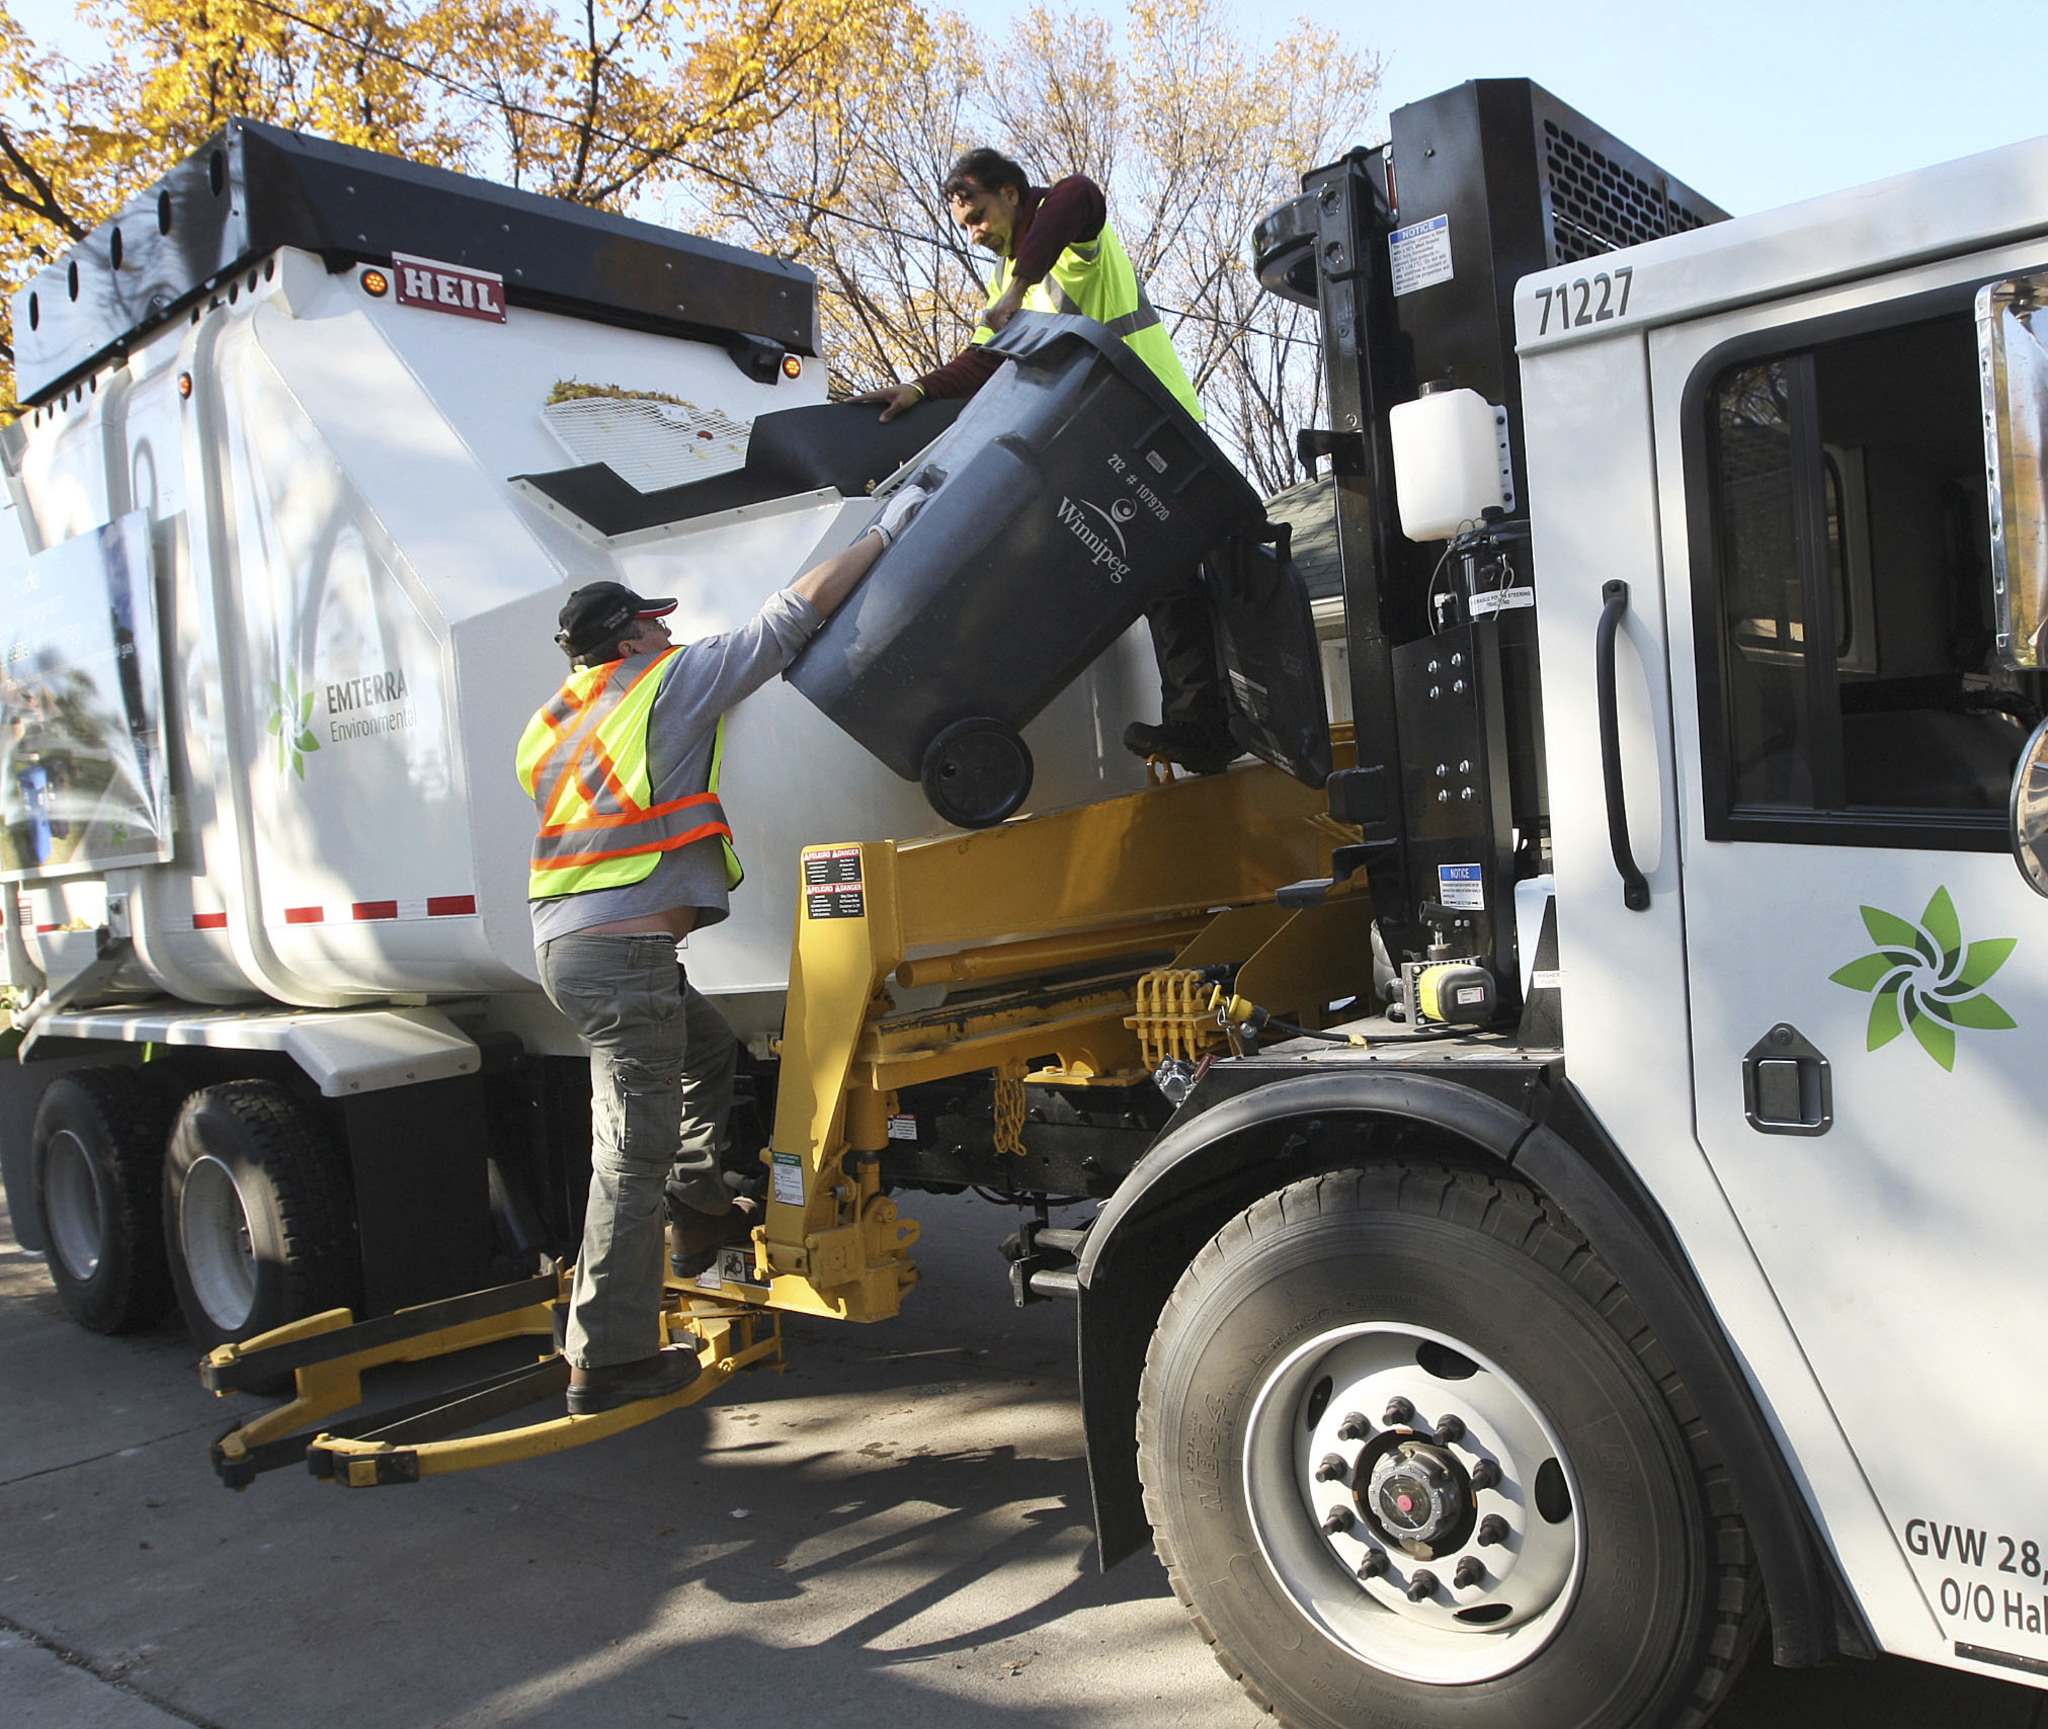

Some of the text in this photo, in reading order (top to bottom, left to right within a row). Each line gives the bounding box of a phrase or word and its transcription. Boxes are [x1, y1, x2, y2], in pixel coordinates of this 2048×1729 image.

[1402, 221, 1435, 240] NOTICE
[403, 267, 501, 314] HEIL
[1535, 266, 1633, 336] 71227
[1107, 453, 1126, 474] 212
[1056, 495, 1131, 584] Winnipeg
[326, 668, 409, 715] EMTERRA
[1905, 1518, 1987, 1567] GVW
[1940, 1577, 1995, 1623] O/O
